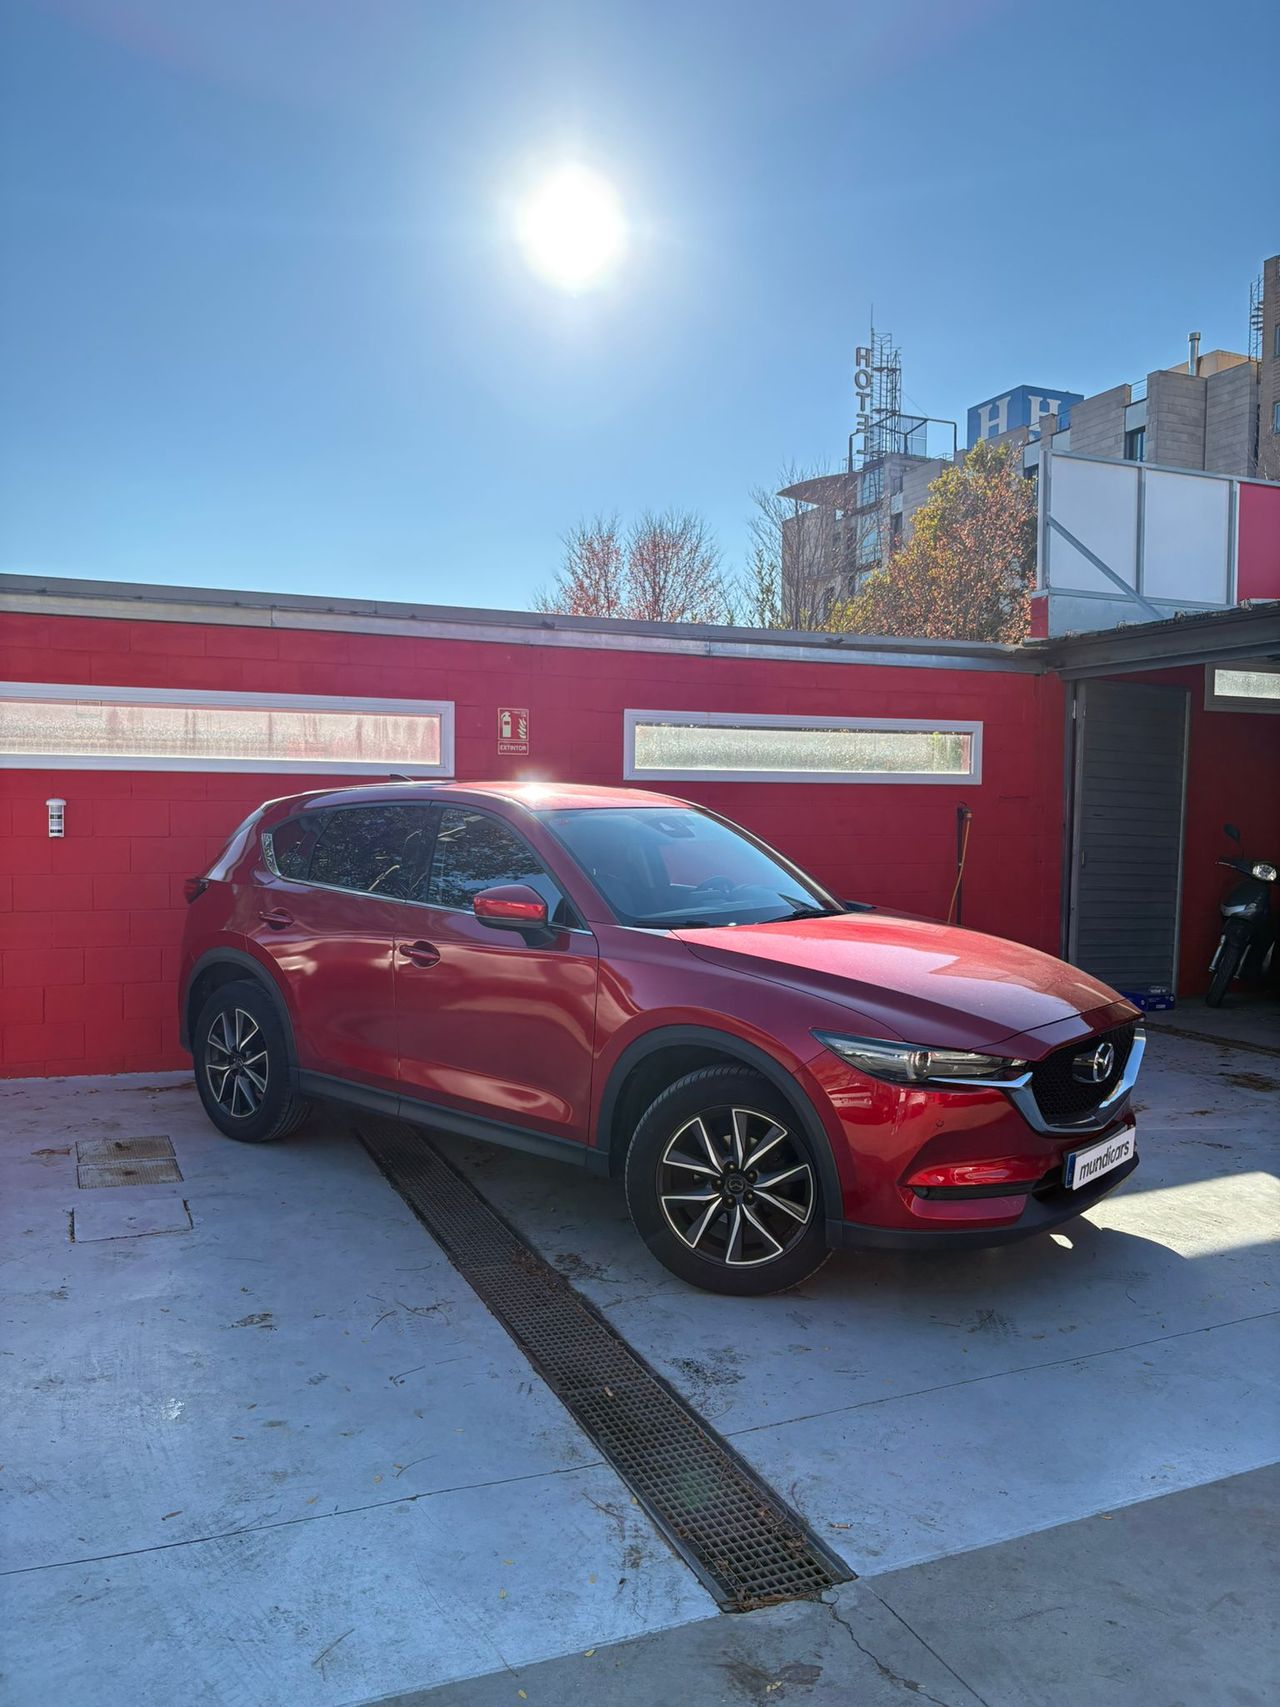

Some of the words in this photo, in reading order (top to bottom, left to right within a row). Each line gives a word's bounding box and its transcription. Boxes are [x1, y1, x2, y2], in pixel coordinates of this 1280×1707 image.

[978, 396, 1011, 440] H
[1028, 395, 1061, 432] H
[1079, 1140, 1130, 1181] mundicars
